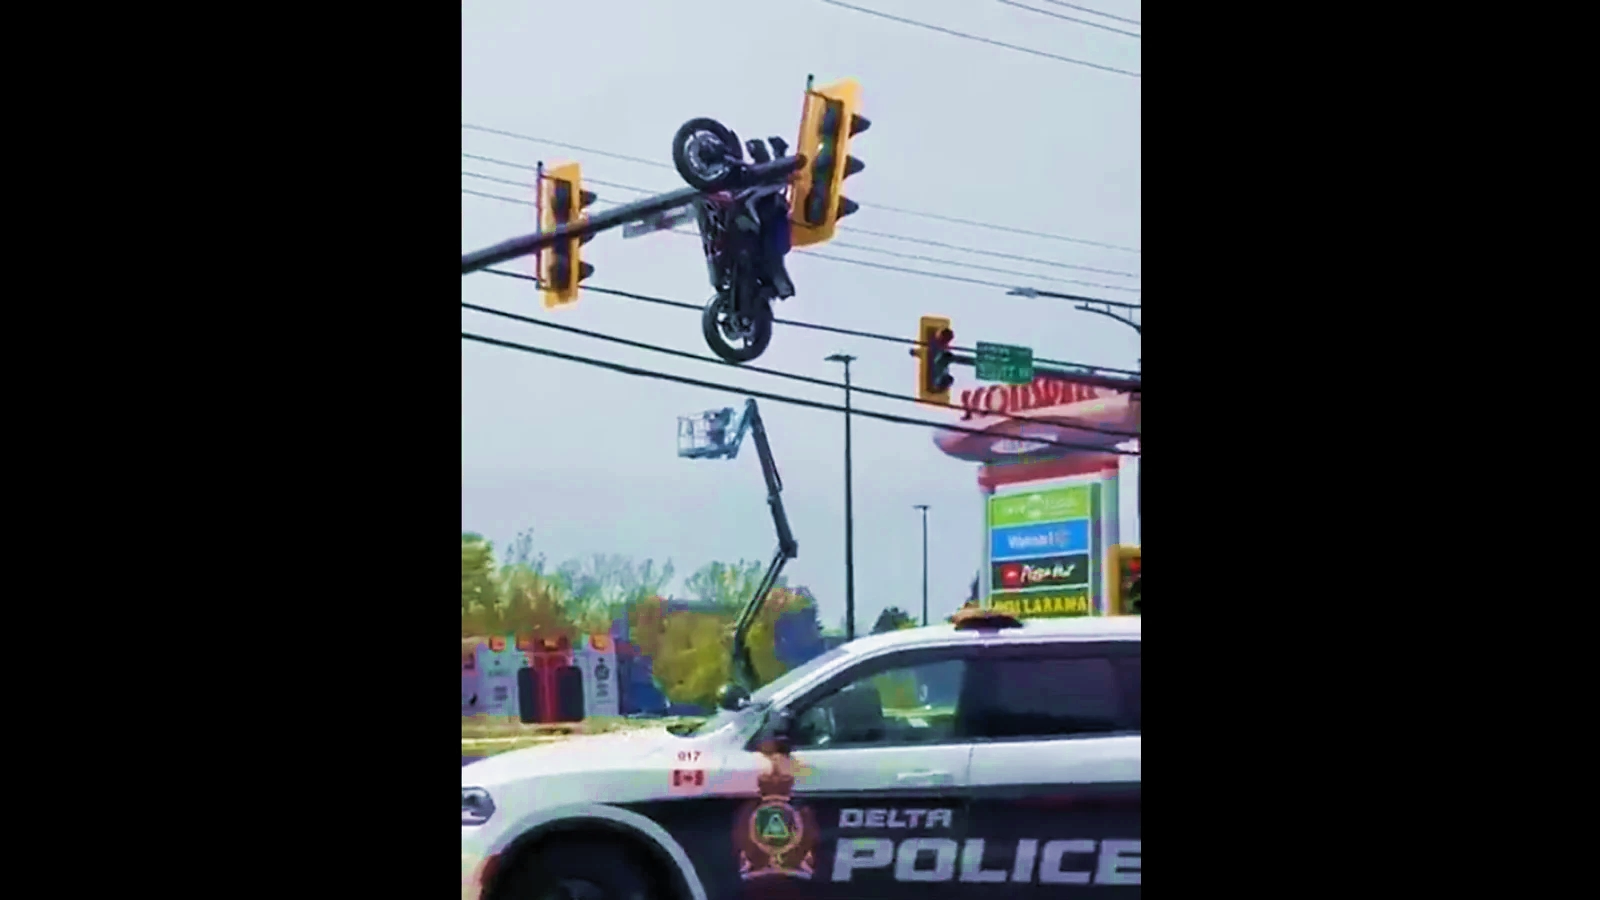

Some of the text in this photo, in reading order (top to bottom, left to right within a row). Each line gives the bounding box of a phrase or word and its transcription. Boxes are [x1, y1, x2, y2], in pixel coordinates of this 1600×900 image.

[677, 750, 702, 762] 017
[838, 808, 953, 828] DELTA
[831, 837, 1141, 885] POLICE
